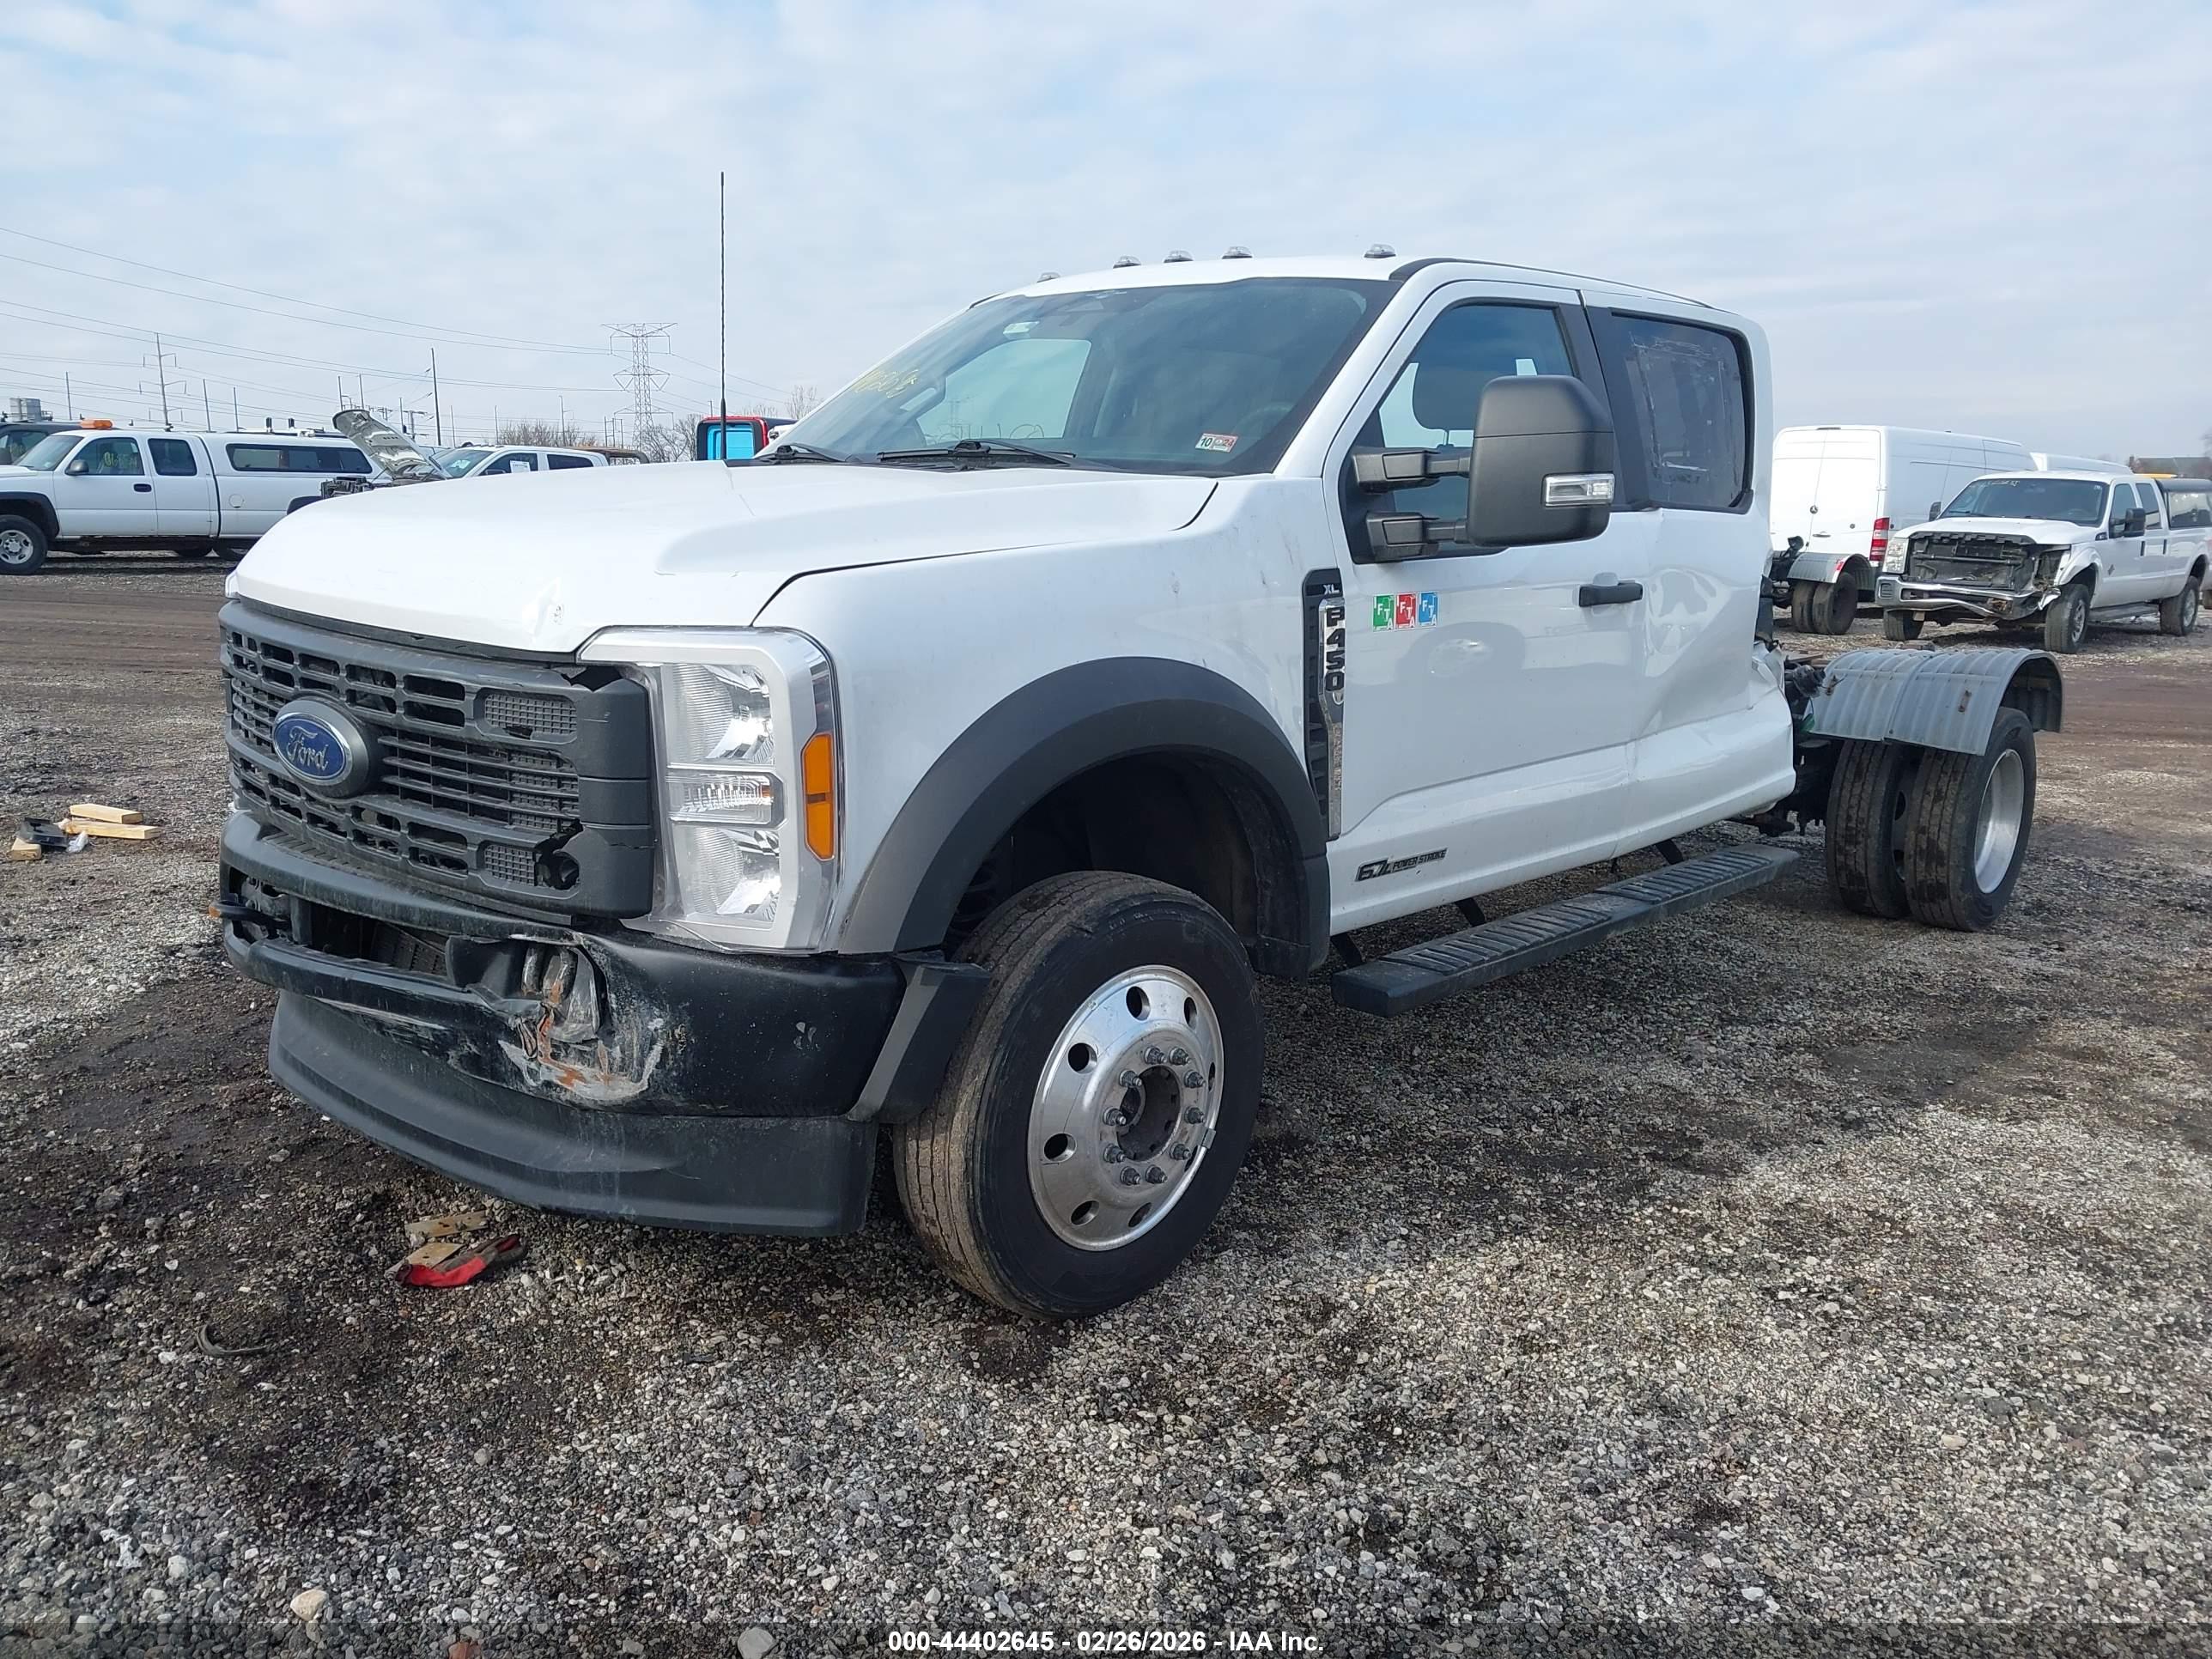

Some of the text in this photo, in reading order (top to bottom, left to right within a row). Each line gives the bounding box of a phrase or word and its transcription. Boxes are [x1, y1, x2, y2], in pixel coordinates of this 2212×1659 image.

[1200, 436, 1212, 447] 10
[1323, 584, 1340, 595] XL
[286, 725, 329, 771] Ford
[1392, 857, 1418, 871] POWER
[1418, 848, 1447, 864] STROKE
